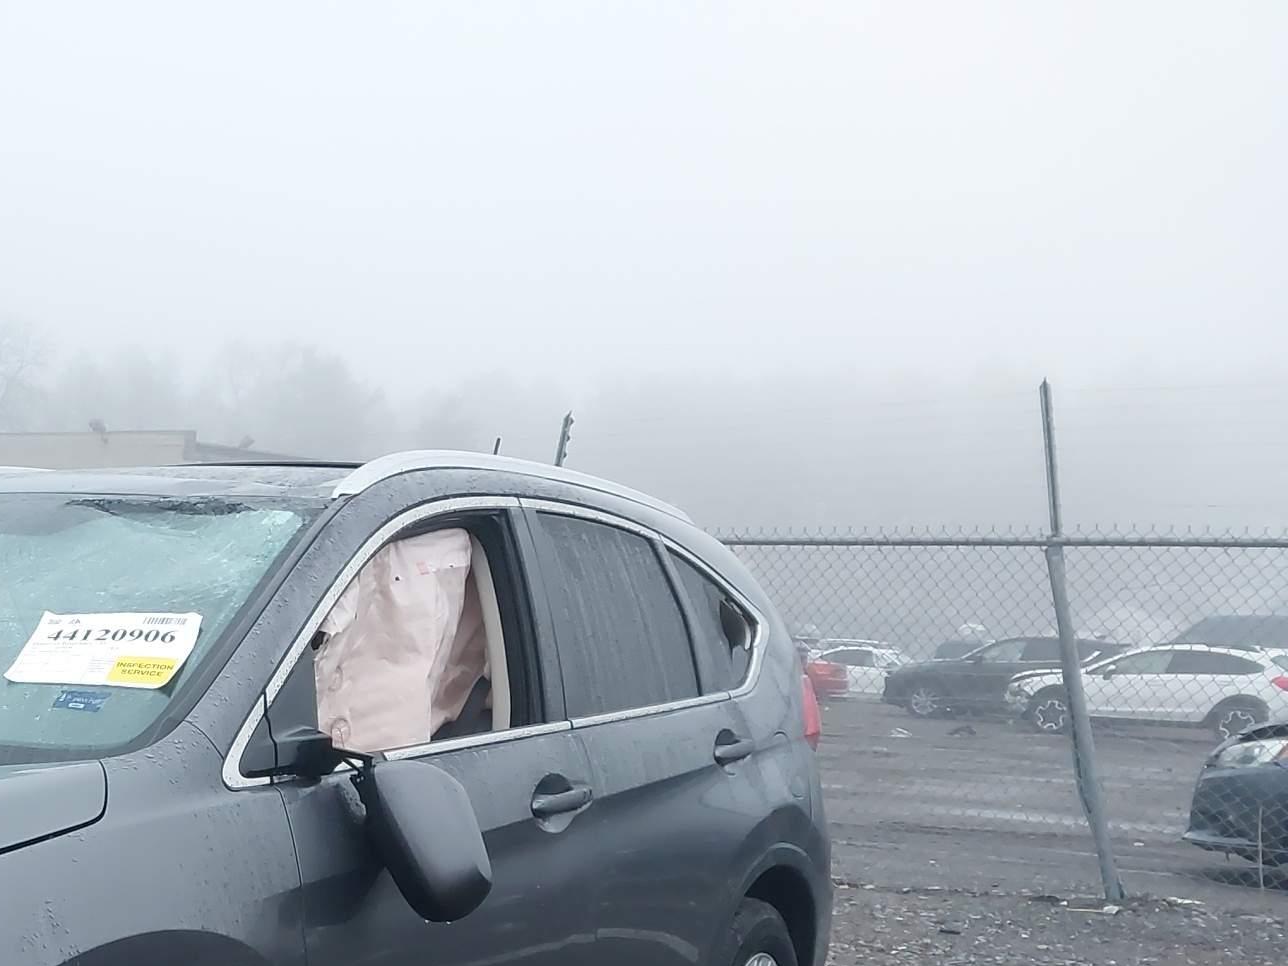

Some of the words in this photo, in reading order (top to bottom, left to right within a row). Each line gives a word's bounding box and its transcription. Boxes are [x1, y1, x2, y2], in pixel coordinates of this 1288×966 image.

[47, 628, 177, 644] 44120906
[116, 661, 174, 671] INSPECTION
[120, 668, 164, 677] SERVICE
